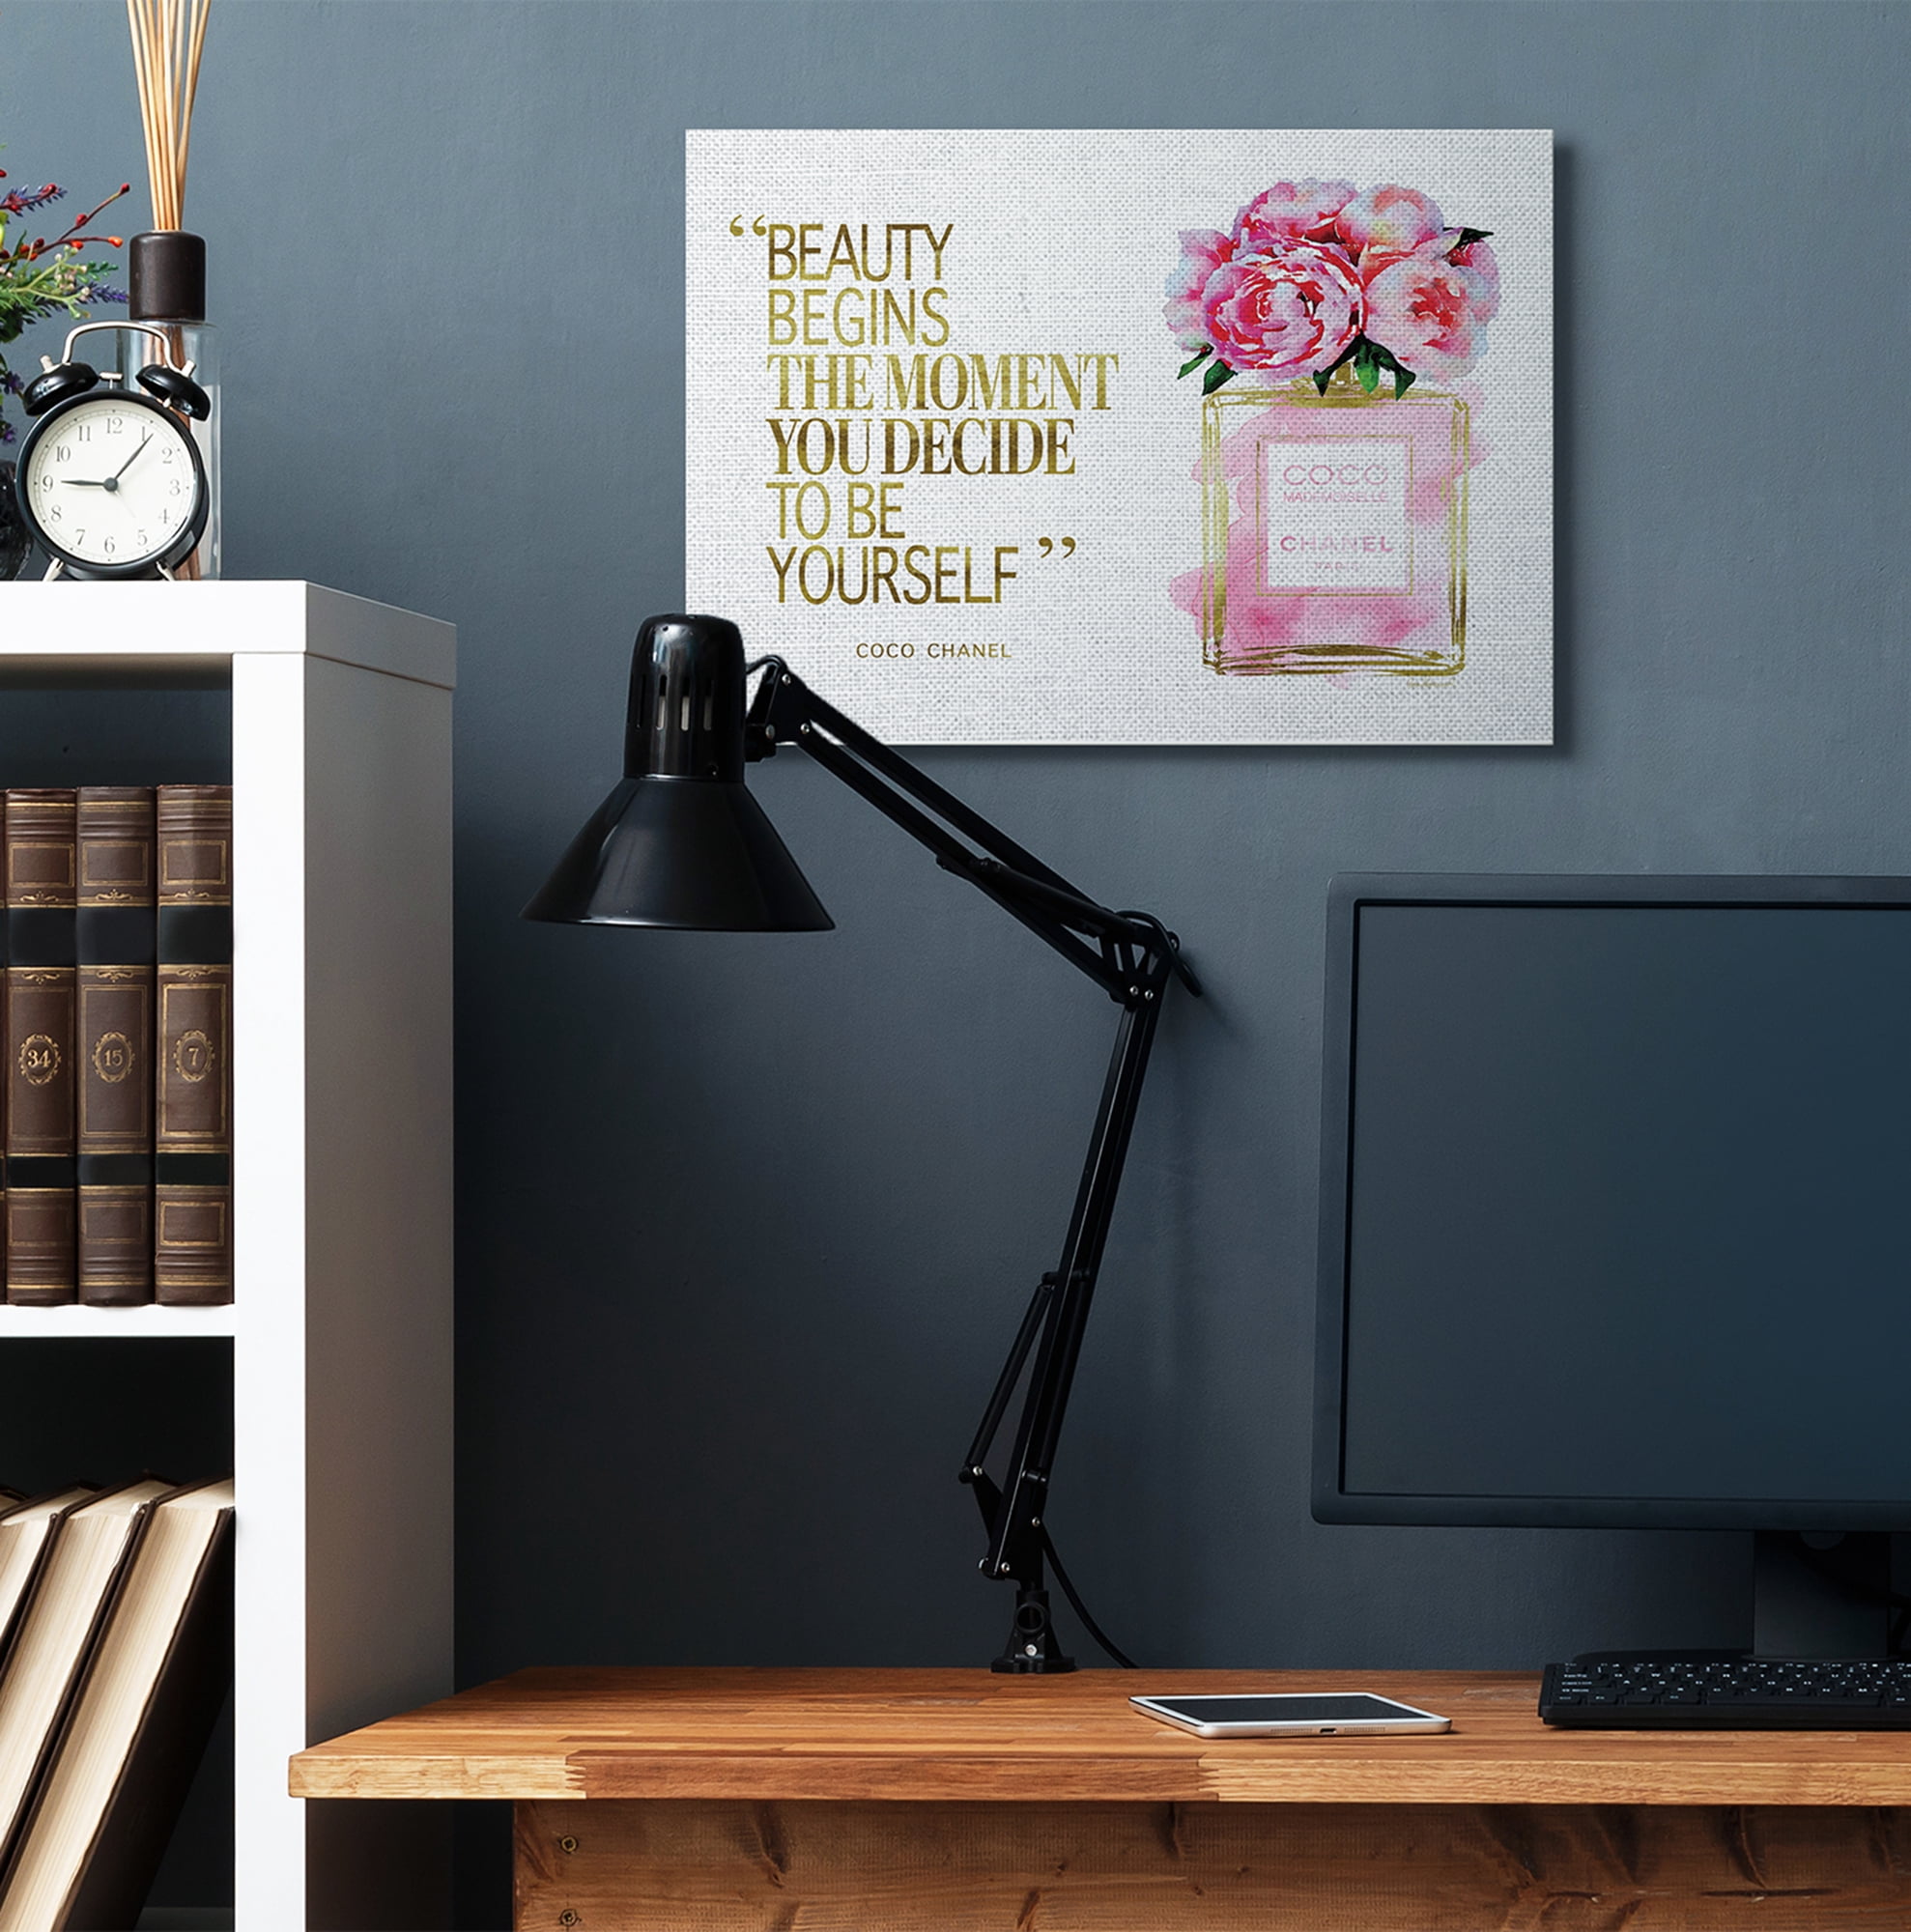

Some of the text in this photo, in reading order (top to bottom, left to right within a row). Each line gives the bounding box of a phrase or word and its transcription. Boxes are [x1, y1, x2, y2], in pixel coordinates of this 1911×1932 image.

[768, 287, 950, 347] BEGINS
[766, 354, 1119, 411] THE MOMENT
[77, 425, 91, 441] 11
[106, 417, 123, 434] 12
[55, 446, 71, 463] 10
[765, 417, 1076, 475] YOU DECIDE
[161, 447, 173, 464] 2
[42, 474, 54, 493] 9
[1283, 465, 1388, 486] COCO
[169, 479, 181, 496] 3
[50, 505, 62, 522] 8
[158, 508, 170, 524] 4
[765, 481, 905, 540] TO BE
[74, 528, 86, 546] 7
[103, 535, 116, 554] 6
[137, 529, 148, 545] 5
[1279, 535, 1394, 552] CHANEL
[856, 643, 1013, 659] COCO CHANEL
[27, 1049, 51, 1067] 34
[104, 1049, 124, 1066] 15
[188, 1048, 199, 1066] 7
